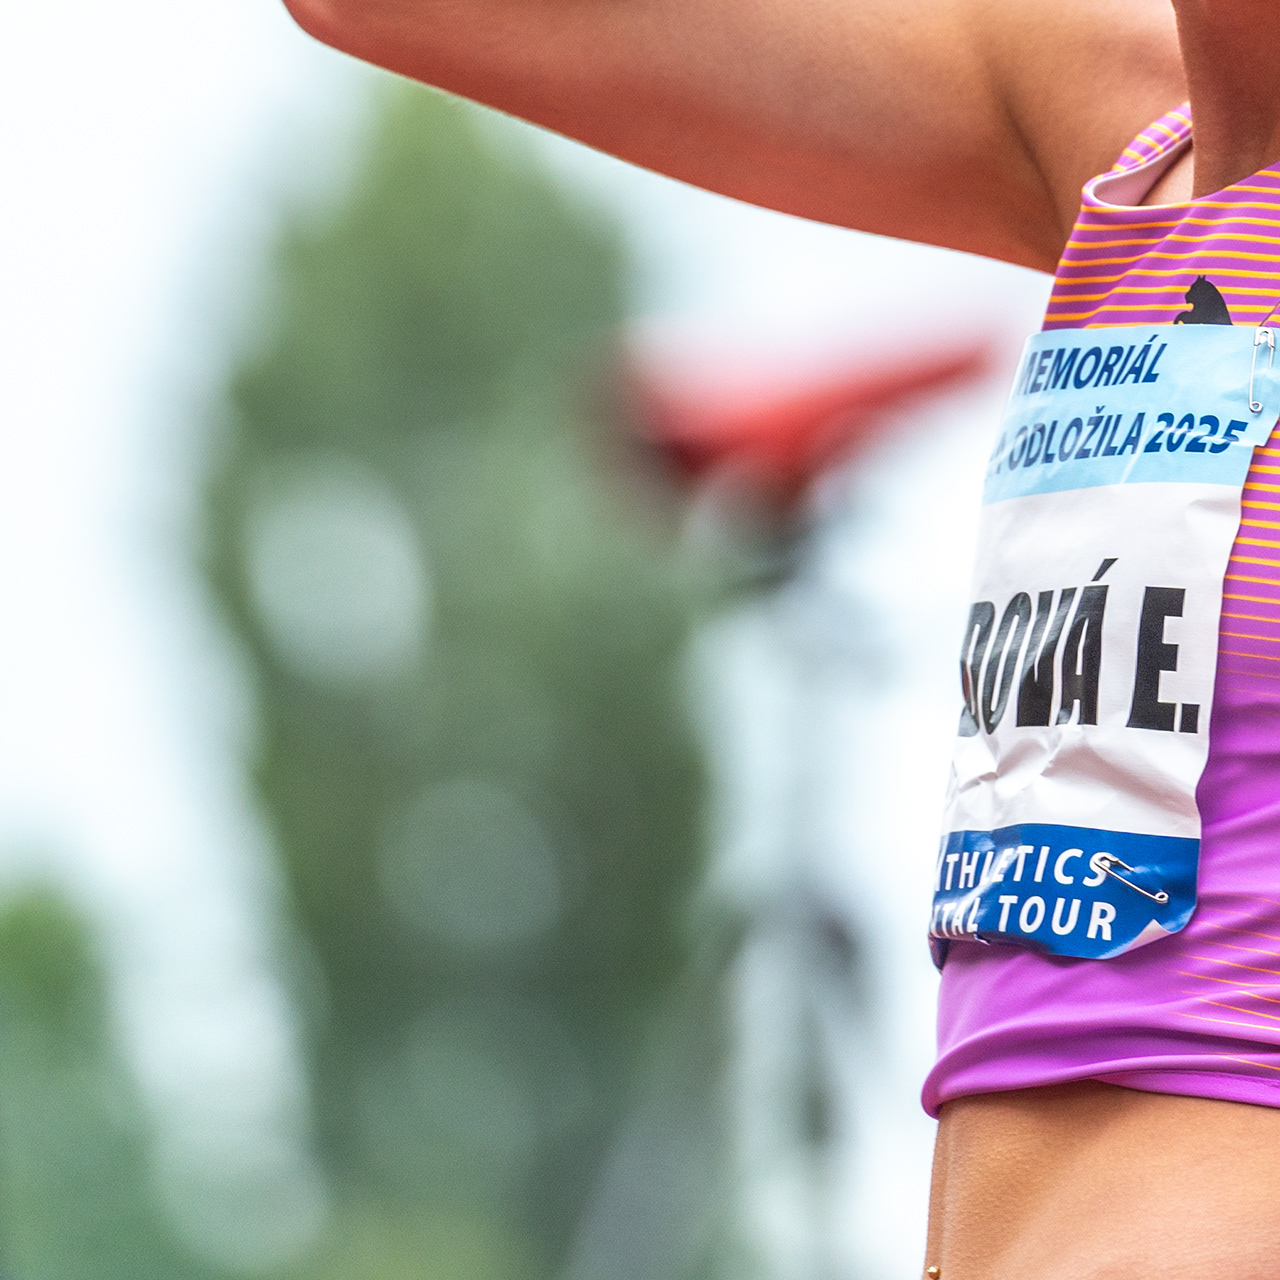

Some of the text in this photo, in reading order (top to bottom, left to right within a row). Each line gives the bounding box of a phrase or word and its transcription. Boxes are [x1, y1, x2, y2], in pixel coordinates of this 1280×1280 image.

[1007, 405, 1146, 472] ODLOŽILA
[1143, 412, 1249, 455] 2025
[1125, 585, 1200, 735] E.
[997, 894, 1117, 942] TOUR
